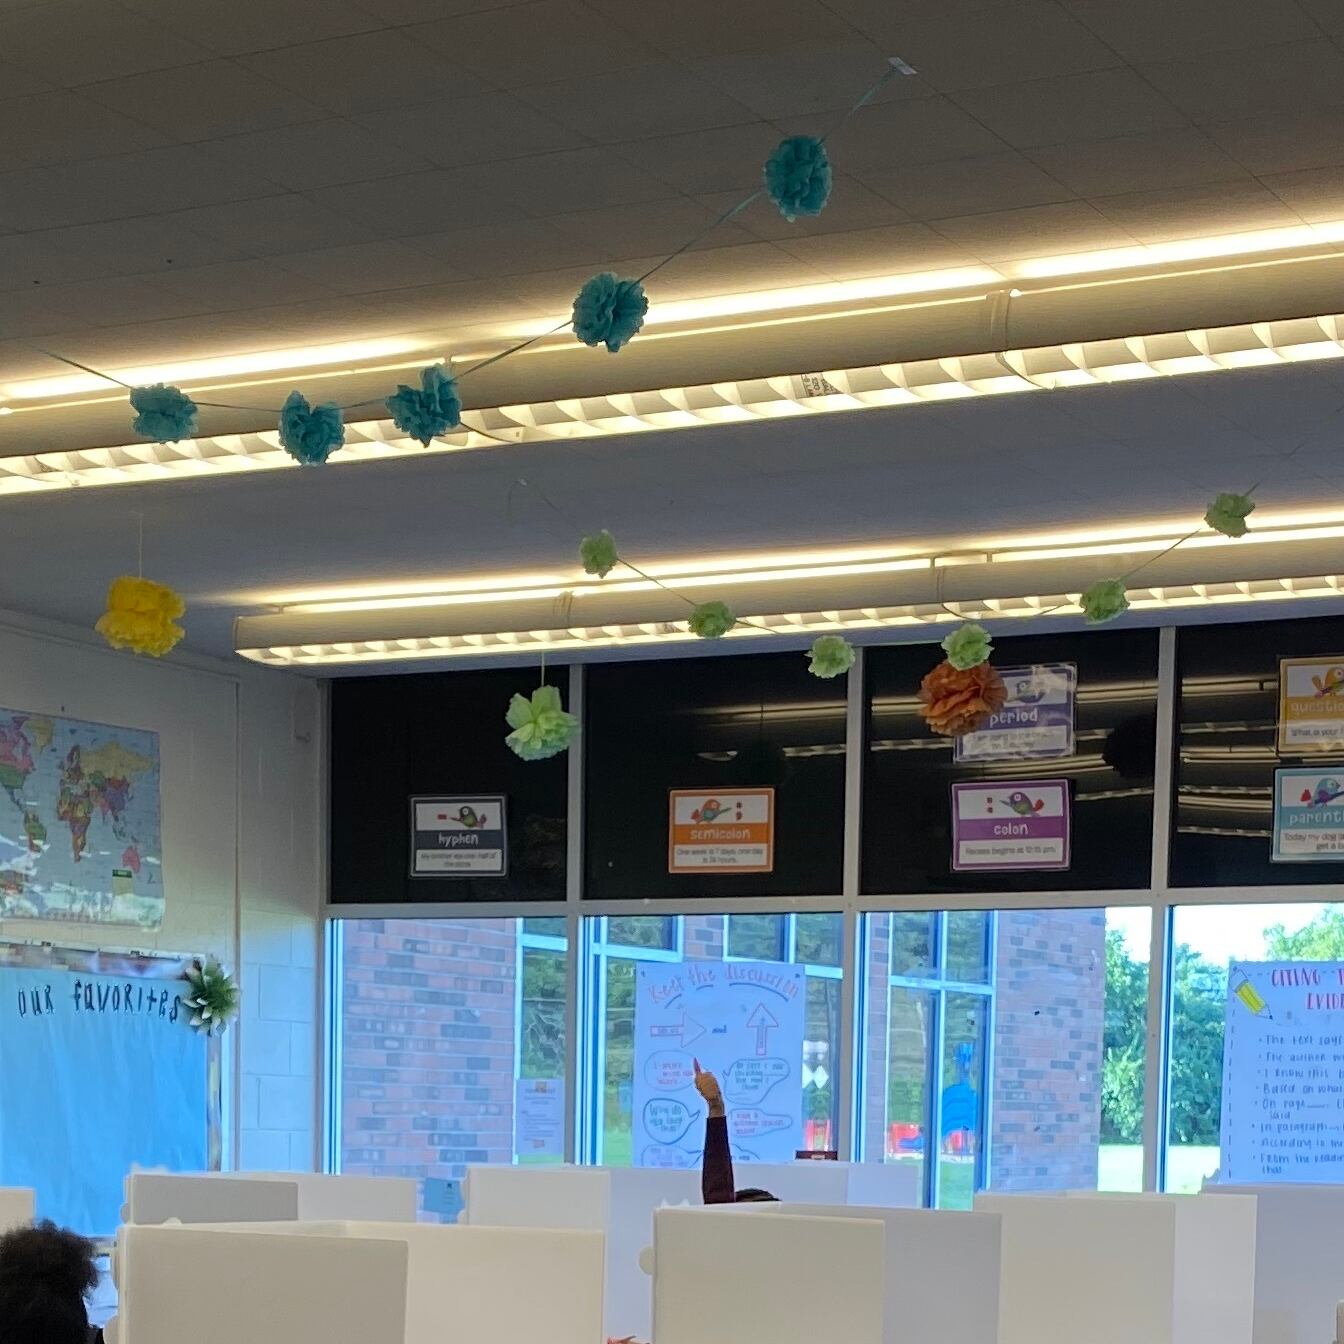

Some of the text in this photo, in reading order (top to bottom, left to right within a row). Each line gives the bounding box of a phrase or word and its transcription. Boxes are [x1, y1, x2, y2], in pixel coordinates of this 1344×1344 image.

[990, 709, 1038, 727] period
[690, 827, 751, 840] semicolon
[993, 822, 1029, 836] colon
[438, 832, 478, 847] hyphen
